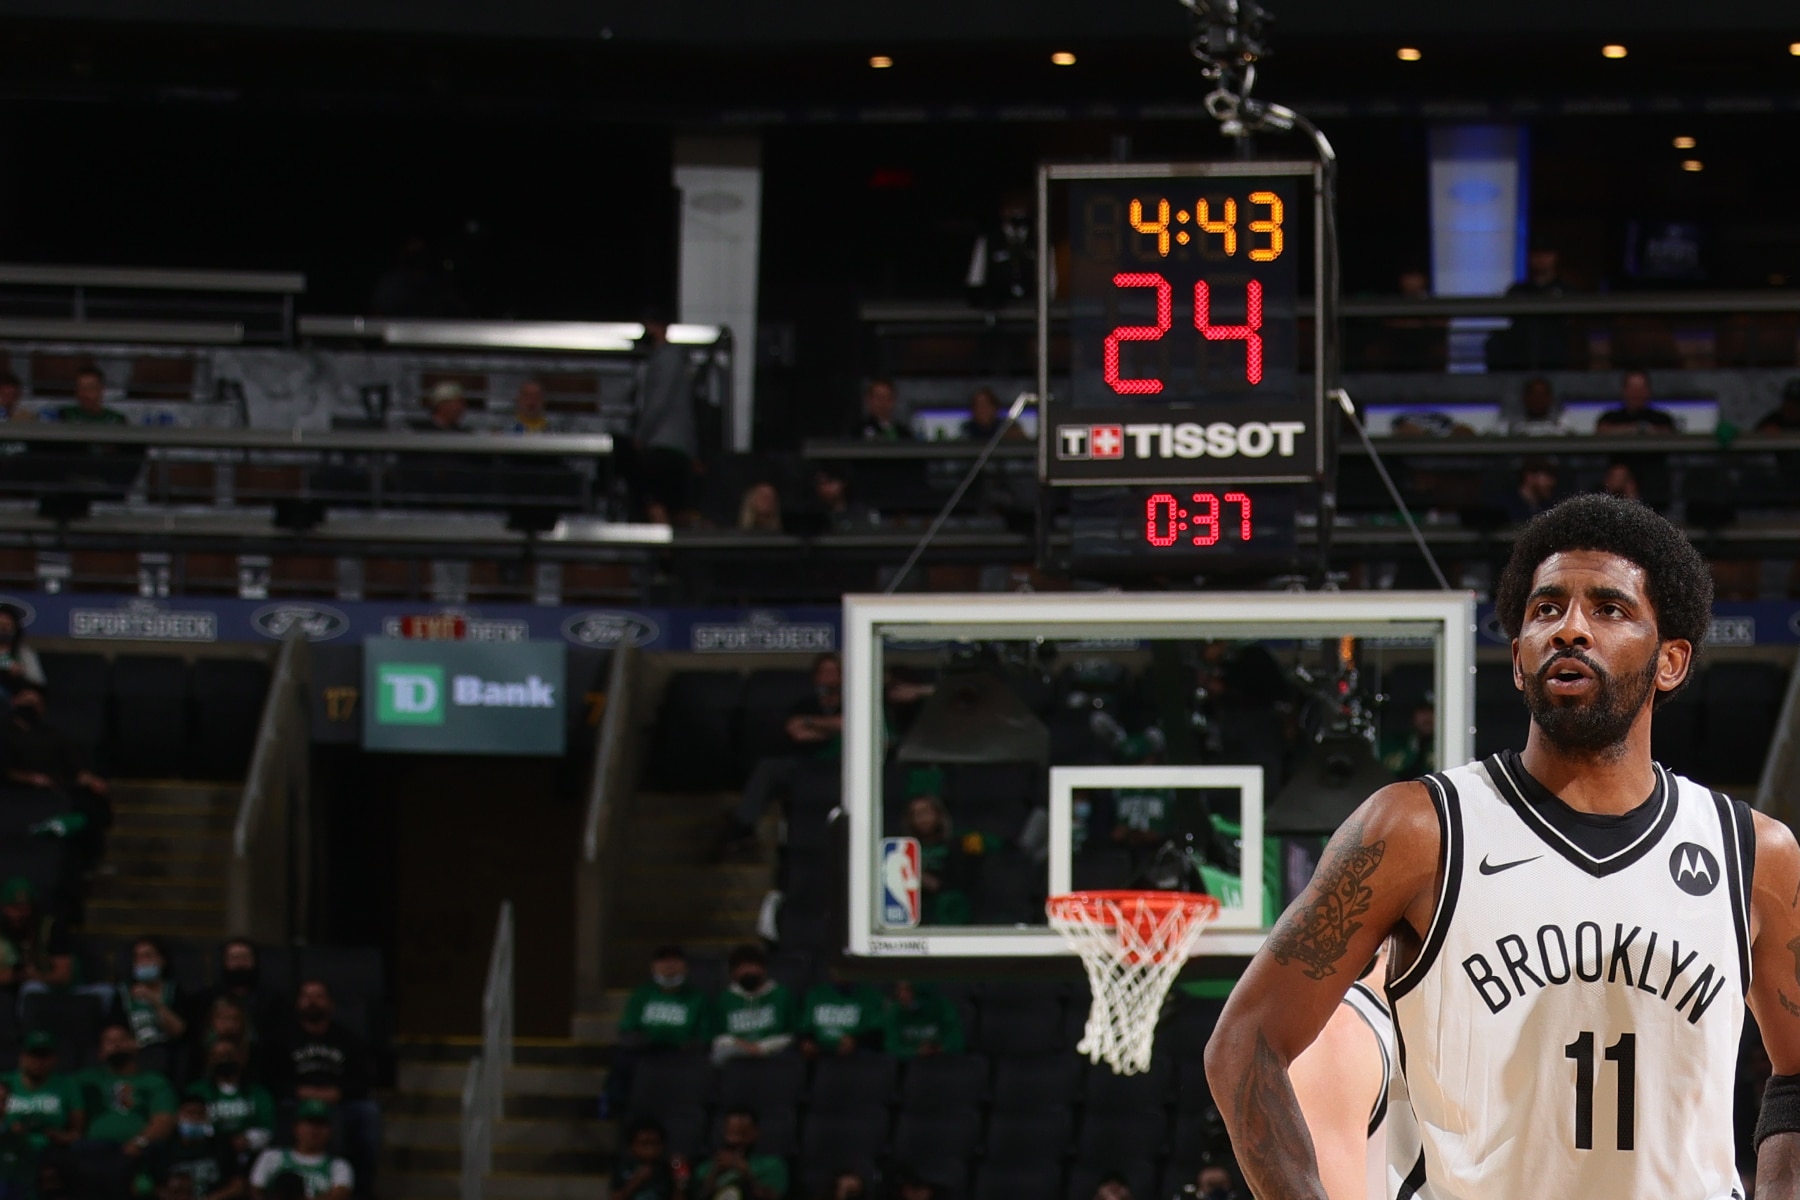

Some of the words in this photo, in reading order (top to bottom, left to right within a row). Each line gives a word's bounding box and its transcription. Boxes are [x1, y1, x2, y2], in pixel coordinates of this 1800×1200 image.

[1129, 191, 1284, 262] 4:43
[1103, 271, 1264, 395] 24
[1125, 421, 1306, 459] TISSOT
[1145, 491, 1252, 547] 0:37
[380, 673, 440, 713] TD
[452, 675, 556, 708] Bank
[1461, 920, 1726, 1025] BROOKLYN
[1565, 1031, 1637, 1151] 11
